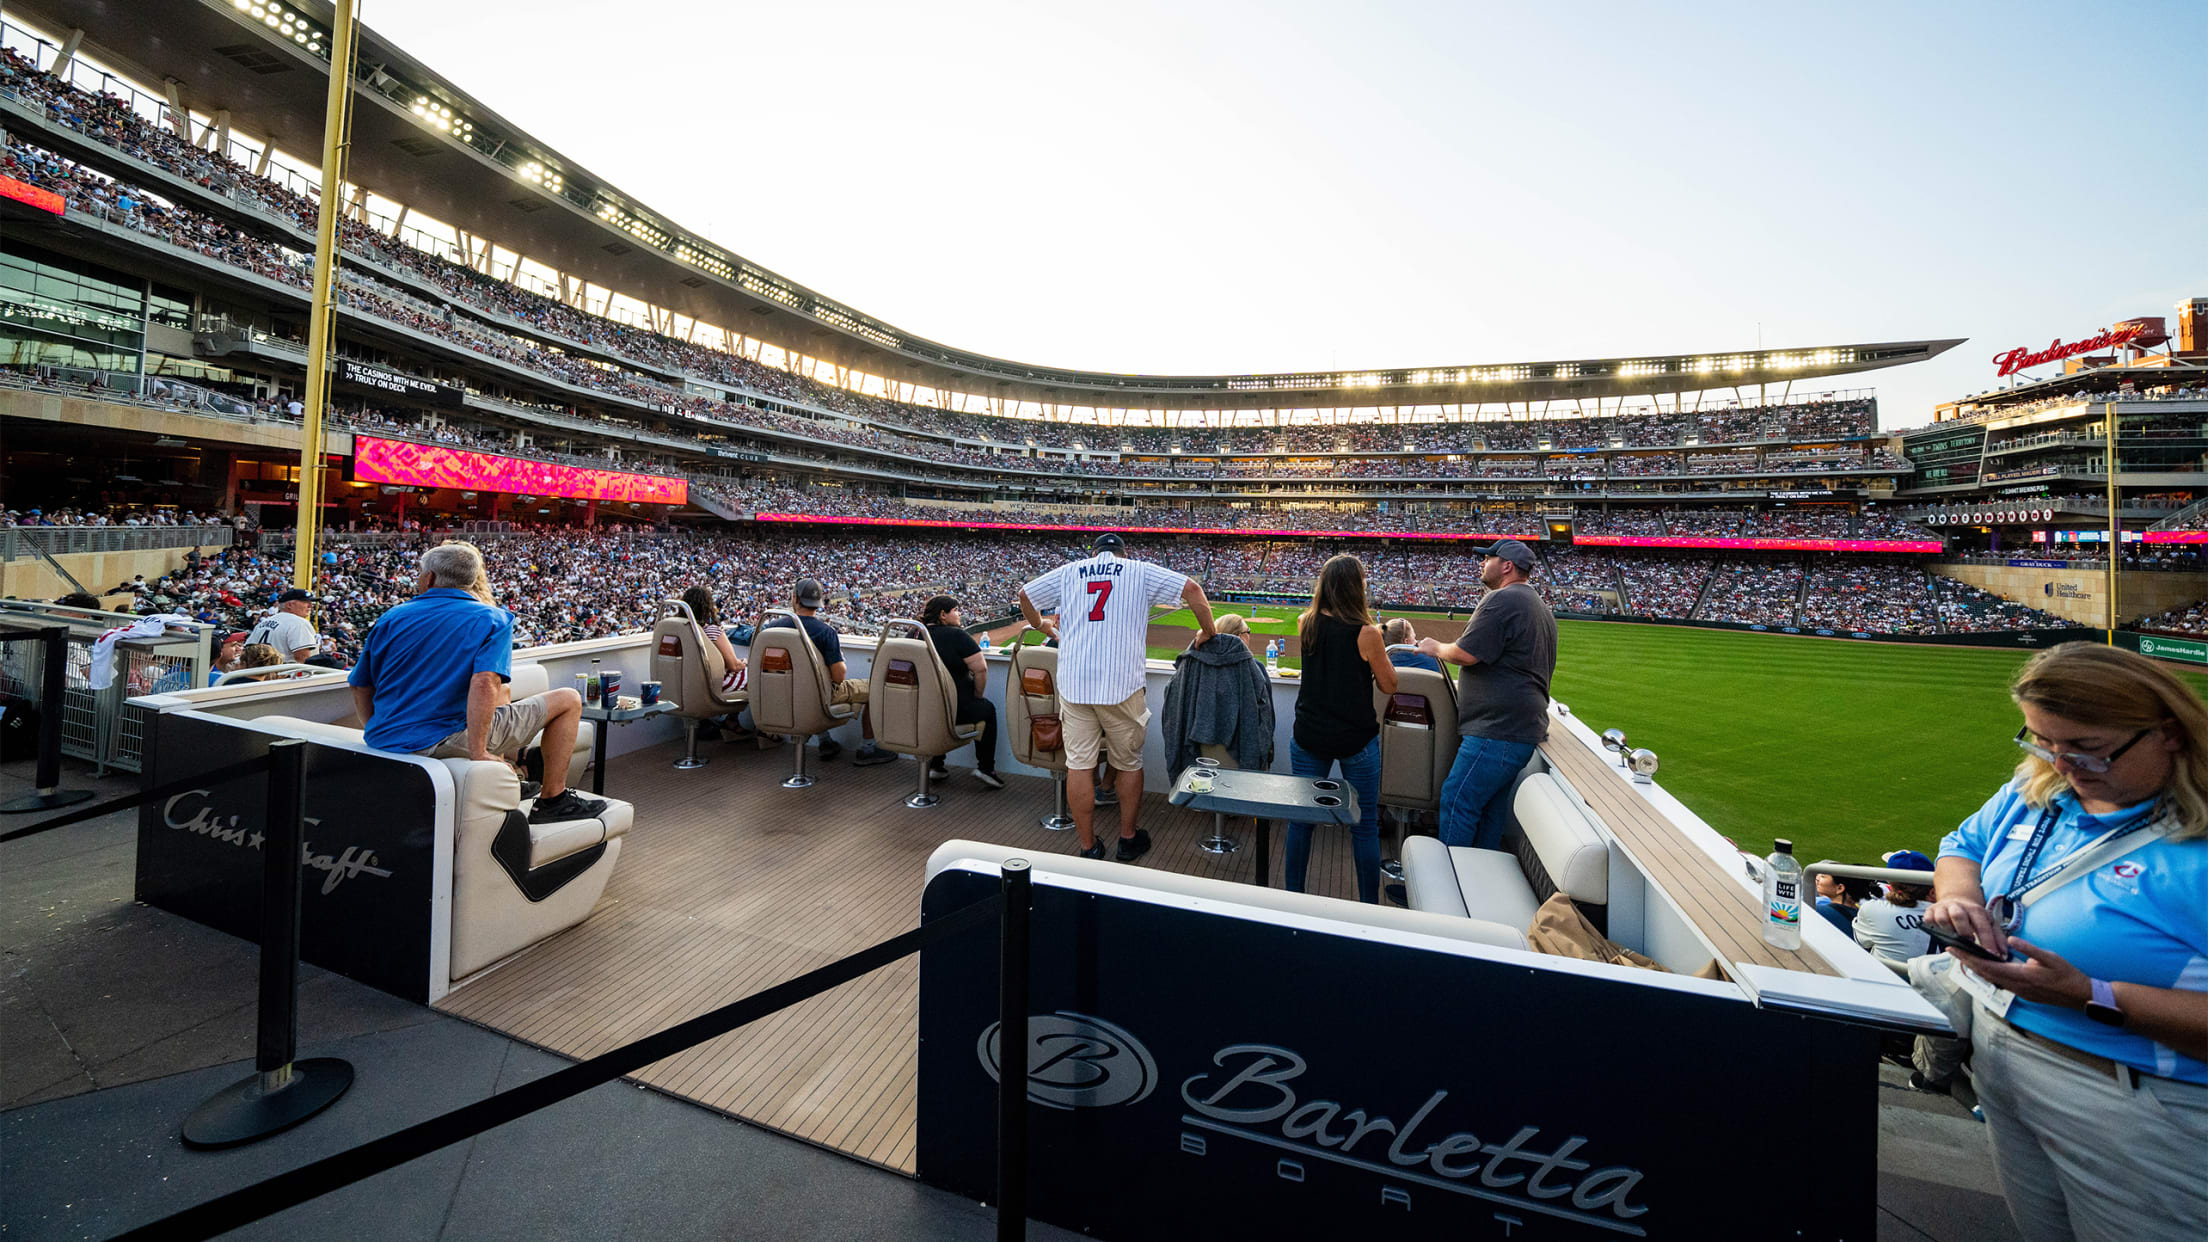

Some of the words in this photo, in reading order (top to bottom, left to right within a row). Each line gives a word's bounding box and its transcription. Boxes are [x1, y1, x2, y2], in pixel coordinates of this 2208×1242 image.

[1993, 324, 2144, 377] Budweiser
[346, 363, 361, 373] THE
[362, 367, 392, 382] CASINOS
[393, 375, 410, 386] WITH
[410, 380, 420, 389] ME
[420, 383, 437, 393] EVER.
[355, 373, 376, 385] TRULY
[377, 379, 388, 389] ON
[388, 382, 406, 393] DECK
[285, 492, 300, 500] GRIL
[1009, 503, 1047, 511] WELCOME
[1079, 563, 1123, 579] MAUER
[2056, 582, 2078, 592] United
[2056, 590, 2092, 600] Healthcare
[1087, 580, 1113, 622] 7
[258, 629, 270, 644] 4
[2156, 644, 2206, 657] JamesHardie
[164, 789, 248, 846] Chris
[301, 817, 393, 896] raft
[2022, 848, 2037, 867] TWINS
[1778, 883, 1794, 891] LIFE
[1778, 889, 1794, 897] WTR
[1896, 914, 1923, 930] CO
[1181, 1044, 1648, 1218] Barletta
